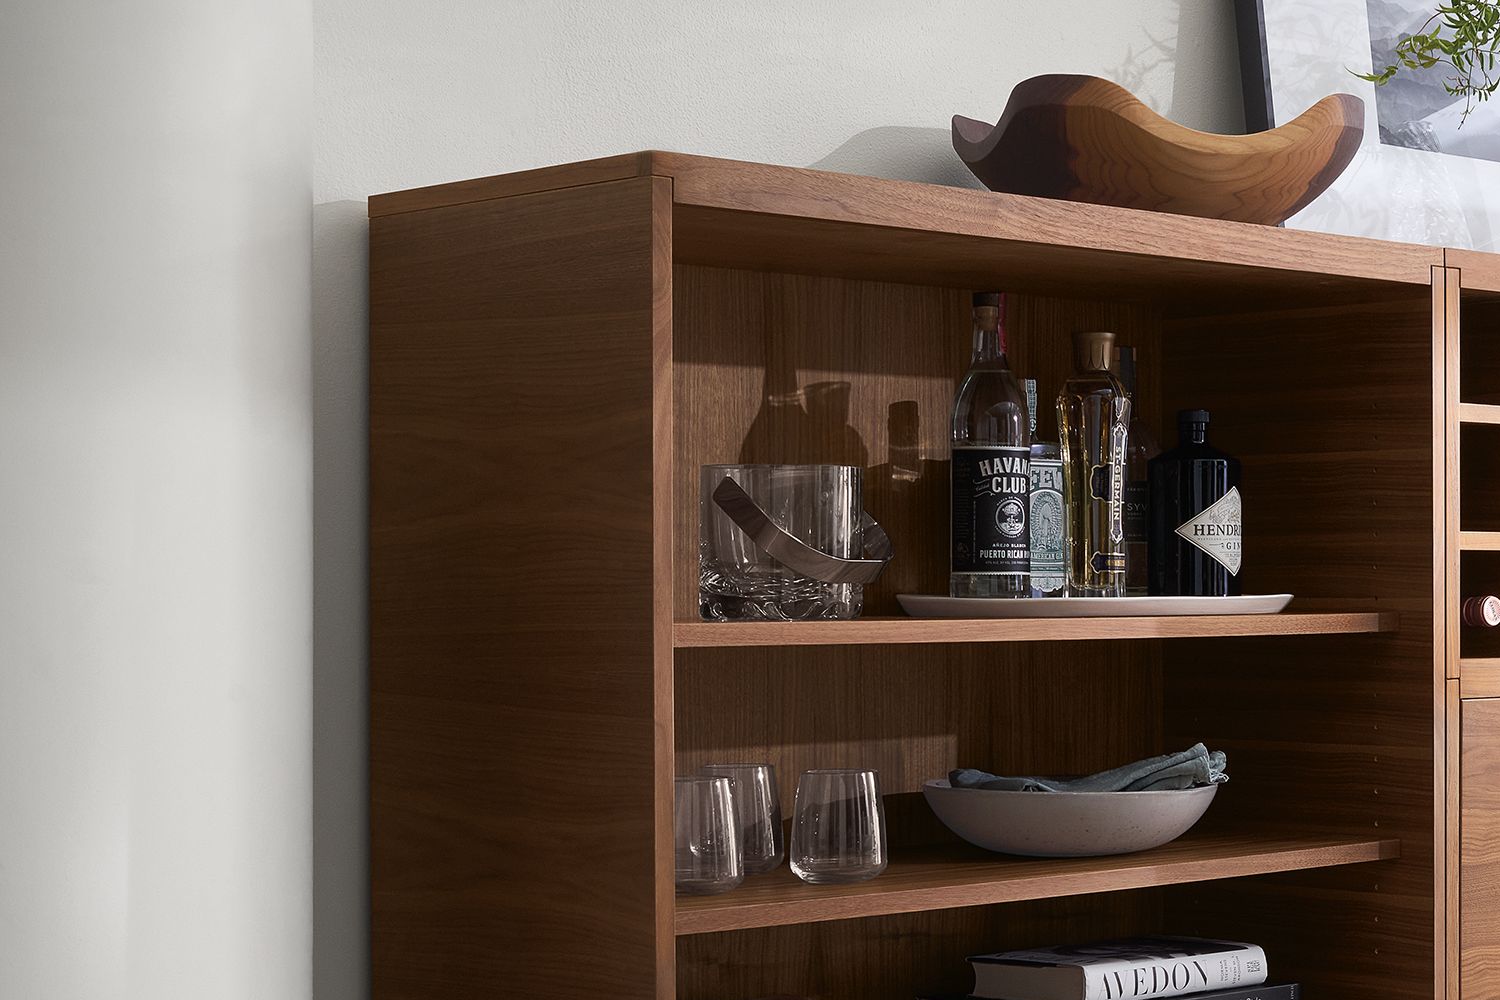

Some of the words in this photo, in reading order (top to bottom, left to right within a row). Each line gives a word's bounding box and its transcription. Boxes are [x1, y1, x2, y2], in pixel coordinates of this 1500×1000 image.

[992, 477, 1026, 493] CLUB
[1113, 446, 1122, 520] ST-GERMAIN
[979, 550, 1006, 559] PUERTO
[1007, 550, 1023, 559] RICAN
[1097, 959, 1208, 1000] AVEDON
